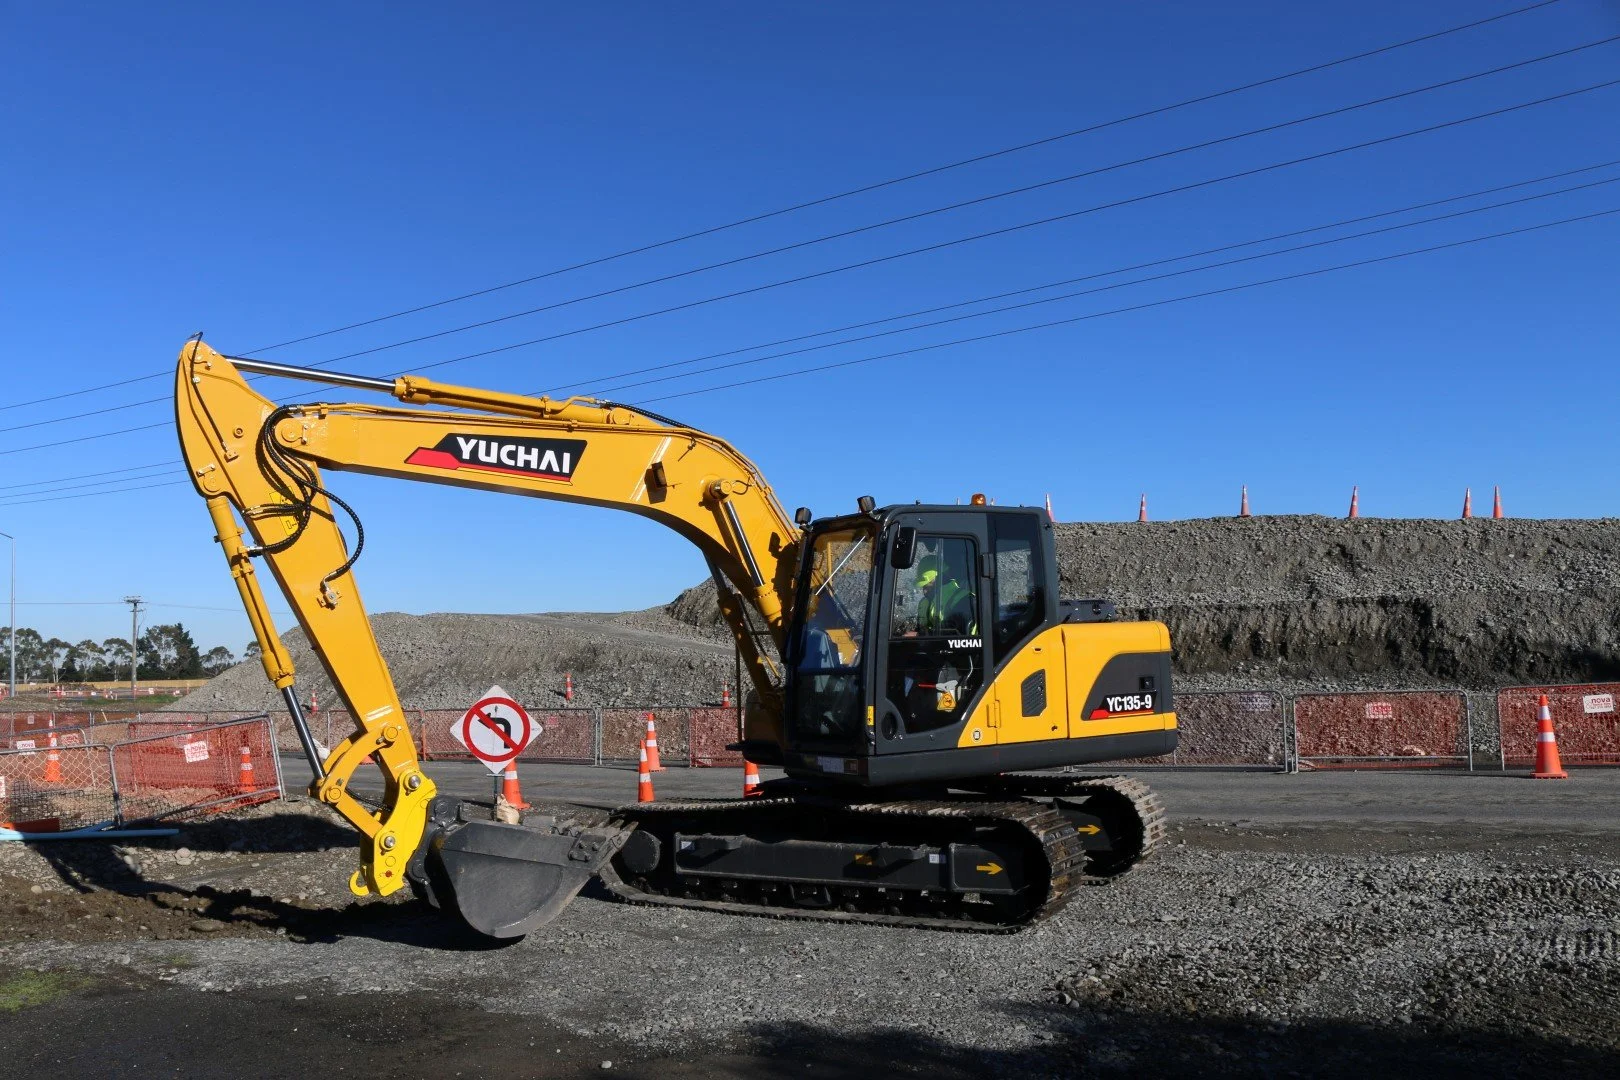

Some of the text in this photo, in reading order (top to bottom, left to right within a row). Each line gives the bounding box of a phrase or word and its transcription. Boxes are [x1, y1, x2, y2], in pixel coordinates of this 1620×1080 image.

[456, 436, 571, 474] YUCHAI
[948, 638, 982, 648] YUCHAI
[1106, 694, 1152, 712] YC135-9
